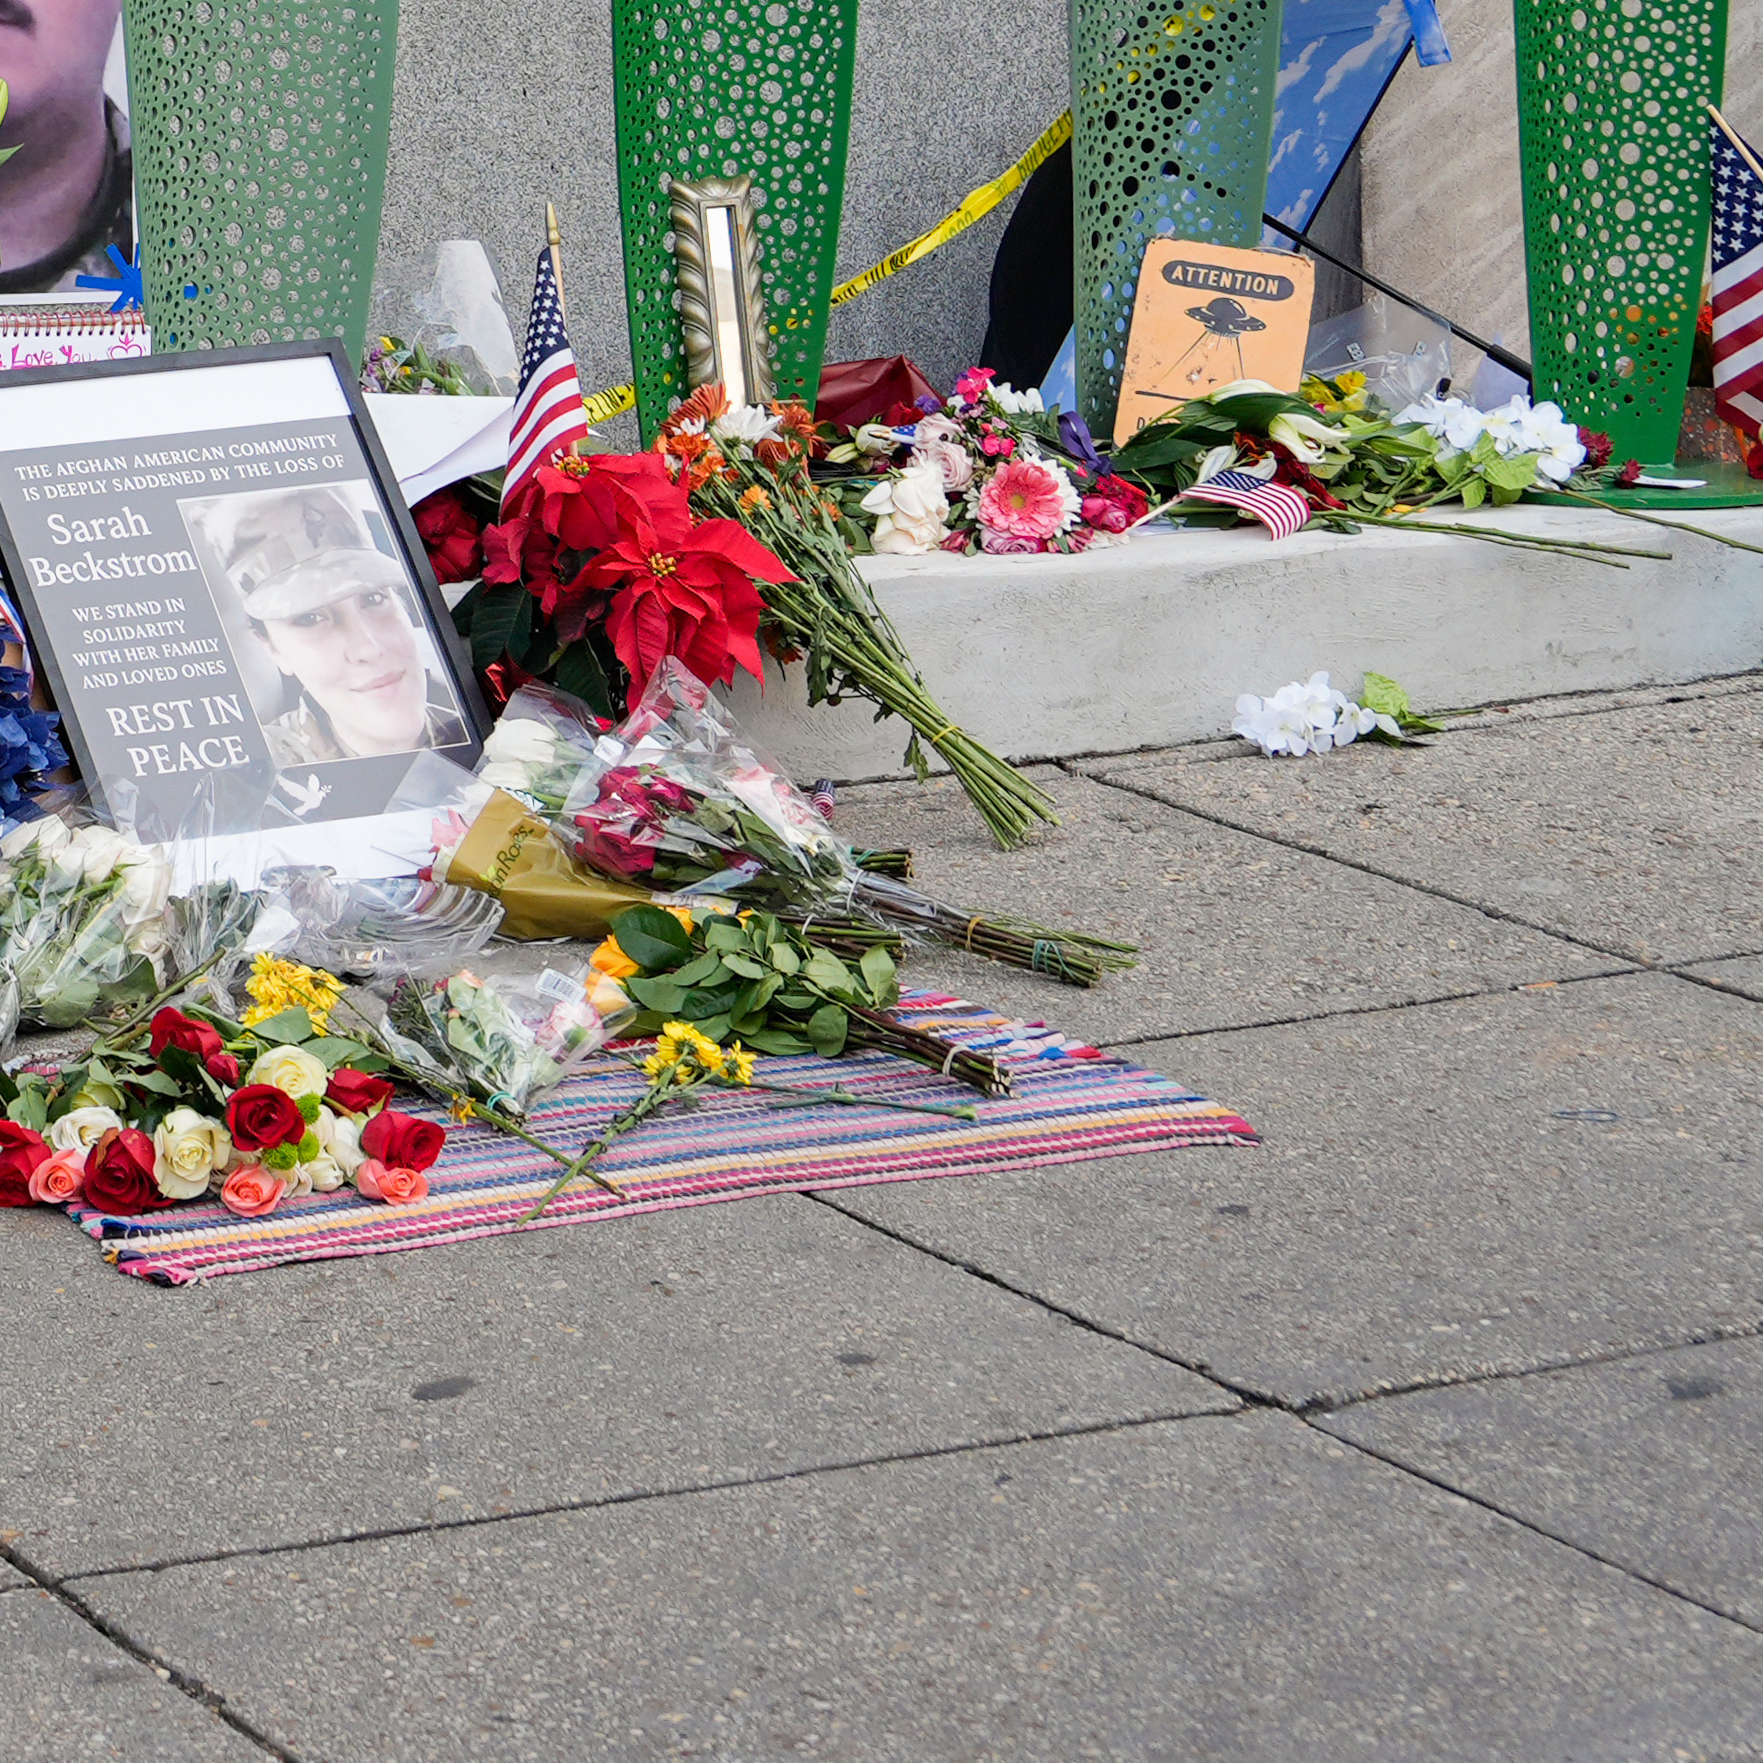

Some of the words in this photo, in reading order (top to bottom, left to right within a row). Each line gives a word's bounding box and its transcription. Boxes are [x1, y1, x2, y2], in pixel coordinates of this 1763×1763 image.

[1171, 265, 1279, 295] ATTENTION
[14, 463, 53, 480] THE
[56, 457, 127, 477] AFGHAN
[132, 446, 226, 469] AMERICAN
[229, 434, 337, 457] COMMUNITY
[23, 488, 40, 502] IS
[45, 480, 109, 499] DEEPLY
[113, 469, 205, 493] SADDENED
[211, 467, 231, 481] BY
[235, 462, 272, 478] THE
[277, 457, 318, 474] LOSS
[322, 455, 344, 469] OF
[46, 507, 152, 545] Sarah
[28, 550, 198, 587] Beckstrom
[72, 606, 103, 622] WE
[105, 600, 162, 619] STAND
[165, 598, 186, 612] IN
[83, 620, 186, 644] SOLIDARITY
[72, 651, 122, 667] WITH
[125, 645, 159, 662] HER
[163, 638, 219, 658] FAMILY
[83, 673, 118, 689] AND
[122, 667, 178, 685] LOVED
[182, 660, 227, 677] ONES
[105, 699, 194, 736] REST
[200, 694, 245, 726] IN
[127, 736, 250, 777] PEACE
